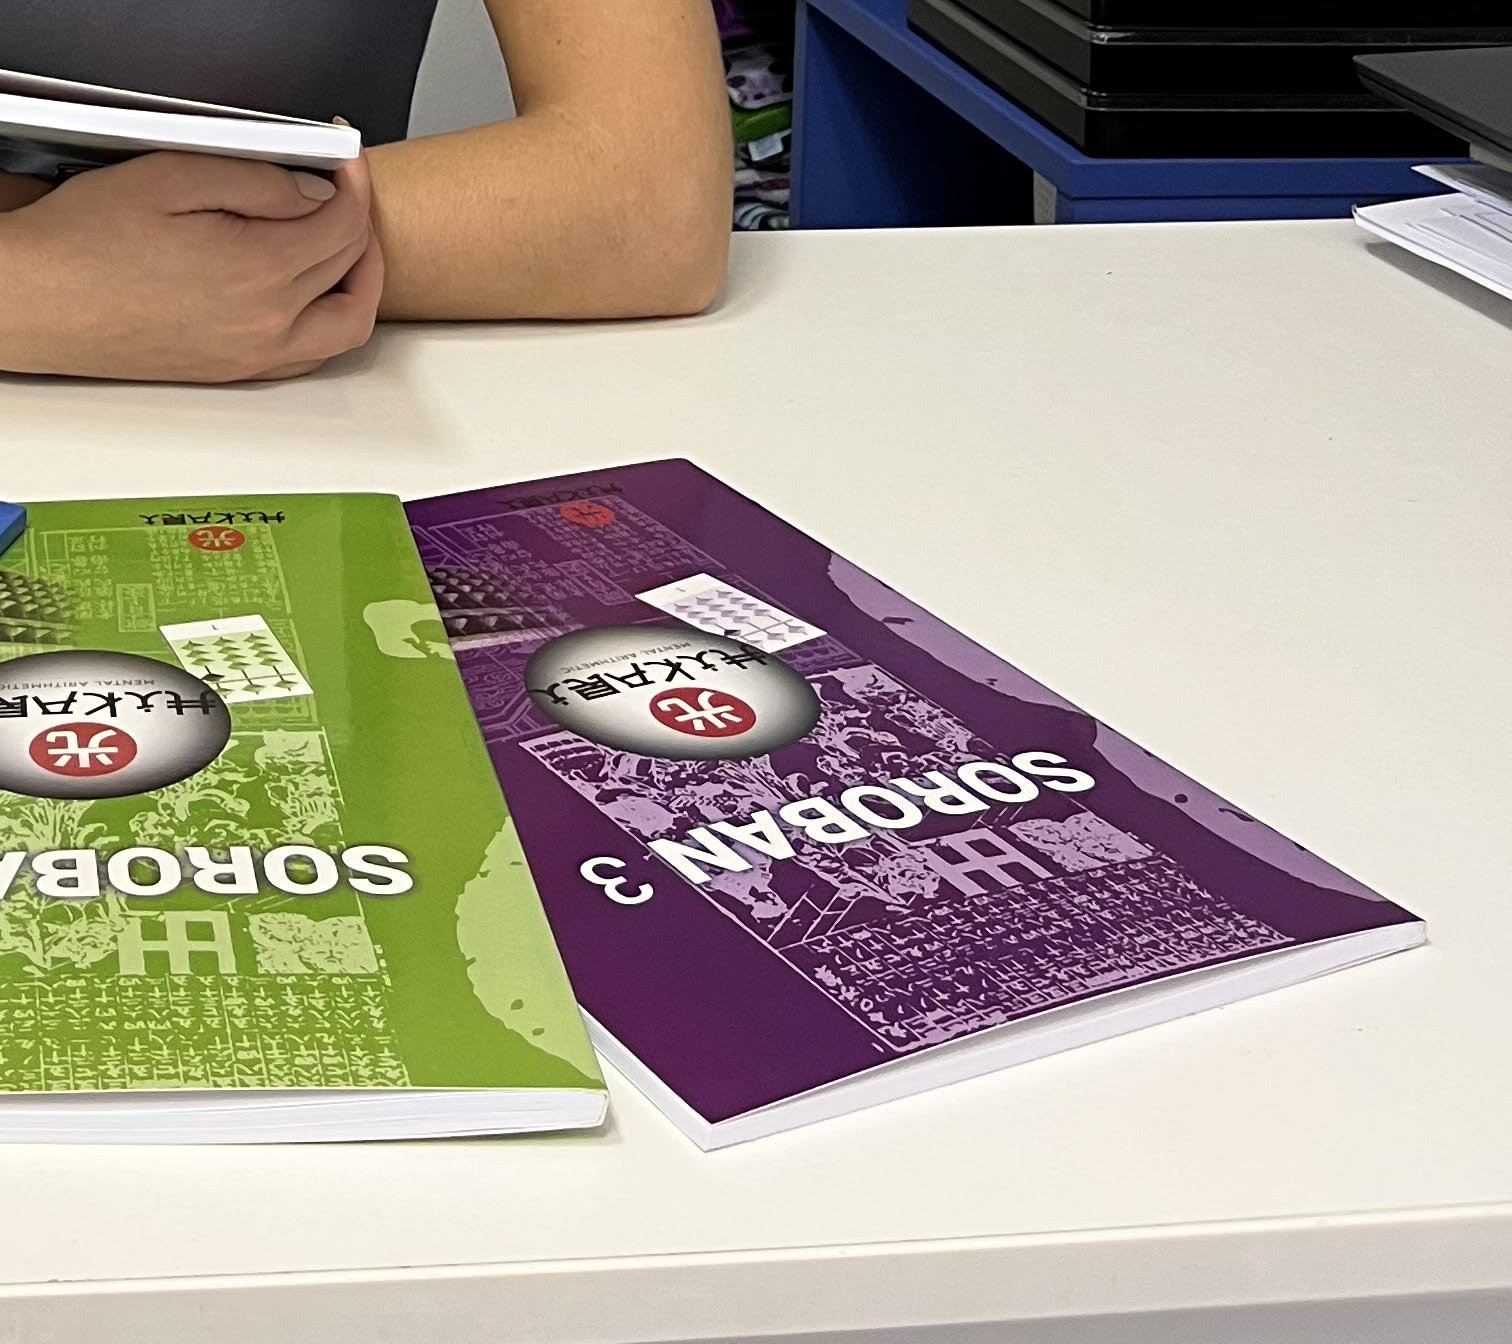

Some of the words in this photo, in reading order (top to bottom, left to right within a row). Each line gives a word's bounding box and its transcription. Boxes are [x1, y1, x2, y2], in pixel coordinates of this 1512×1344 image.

[94, 678, 156, 689] MENTAL
[559, 652, 637, 675] ARITHMETIC
[658, 690, 748, 732] 光
[48, 727, 120, 767] 光
[646, 750, 1097, 885] SOROBAN
[579, 856, 656, 907] 3
